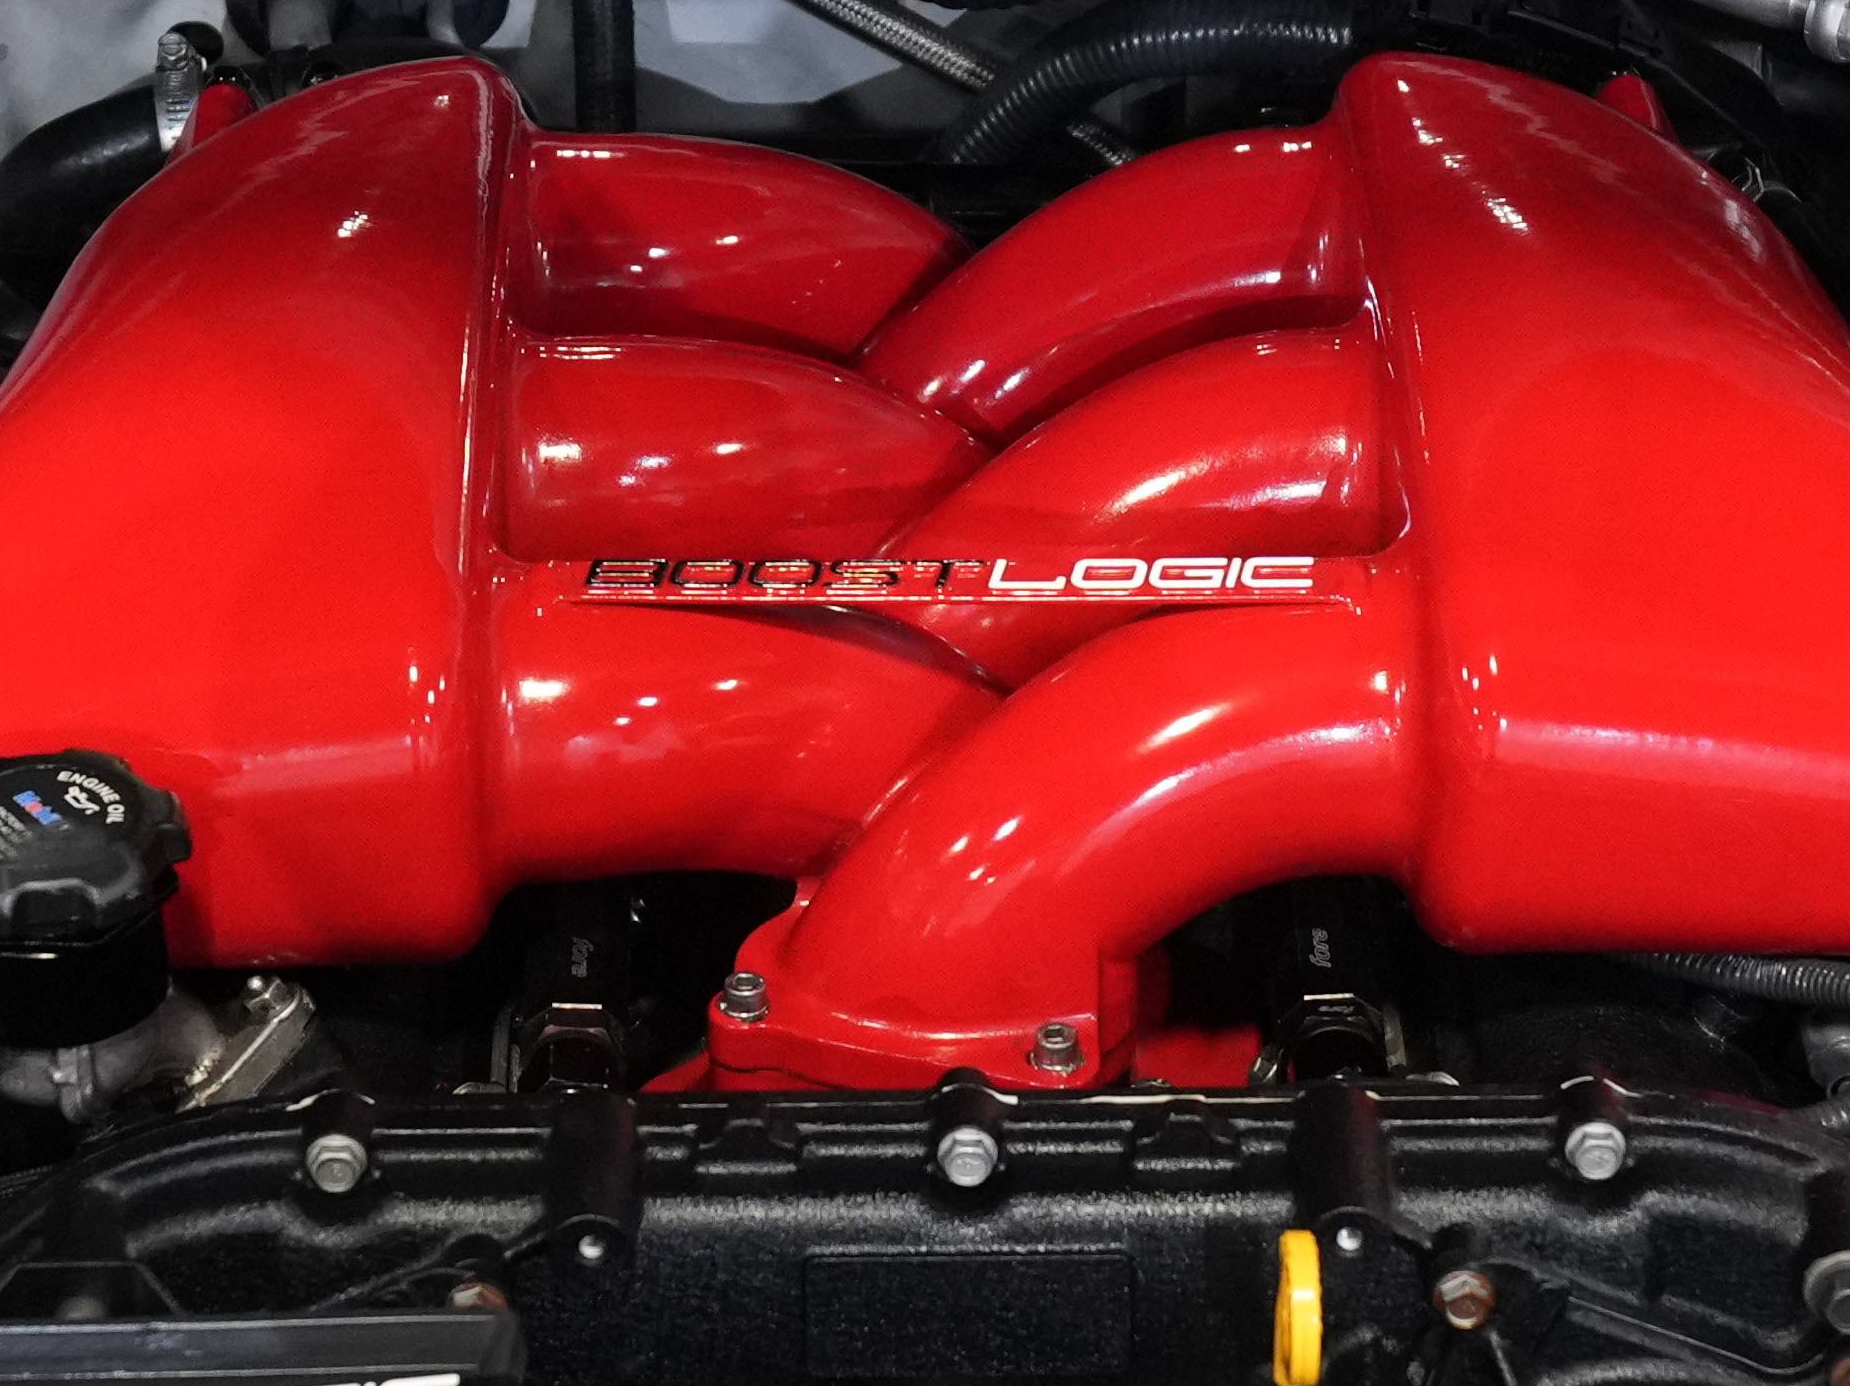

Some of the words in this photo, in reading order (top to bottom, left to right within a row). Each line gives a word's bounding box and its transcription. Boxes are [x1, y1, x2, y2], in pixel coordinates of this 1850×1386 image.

[56, 770, 121, 804] ENGINE
[105, 803, 126, 825] OIL
[1309, 927, 1332, 968] fore
